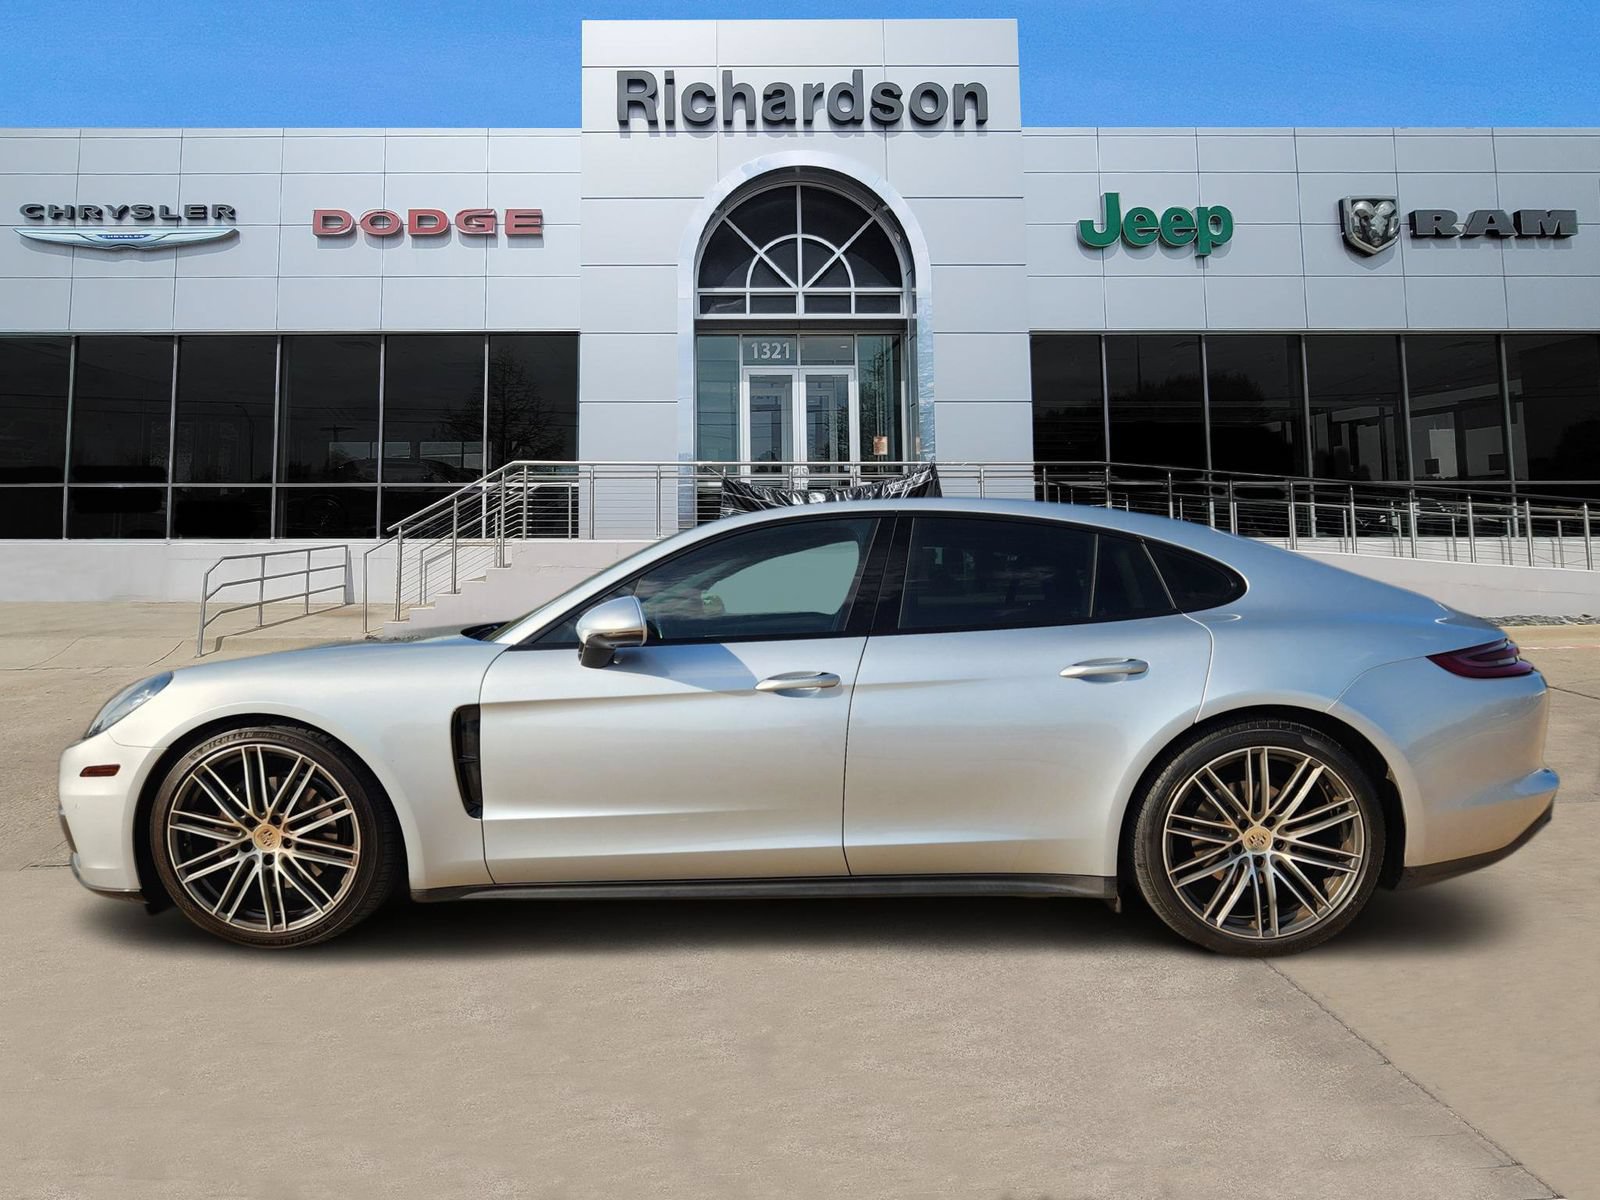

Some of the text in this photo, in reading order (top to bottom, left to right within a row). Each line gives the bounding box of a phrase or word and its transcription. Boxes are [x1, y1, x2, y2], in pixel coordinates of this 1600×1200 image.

[617, 69, 988, 126] Richardson
[20, 204, 237, 220] CHRYSLER
[313, 208, 544, 237] DODGE
[1077, 192, 1234, 257] Jeep
[1409, 209, 1578, 237] RAM
[751, 342, 791, 360] 1321
[202, 731, 254, 752] MICHELIN
